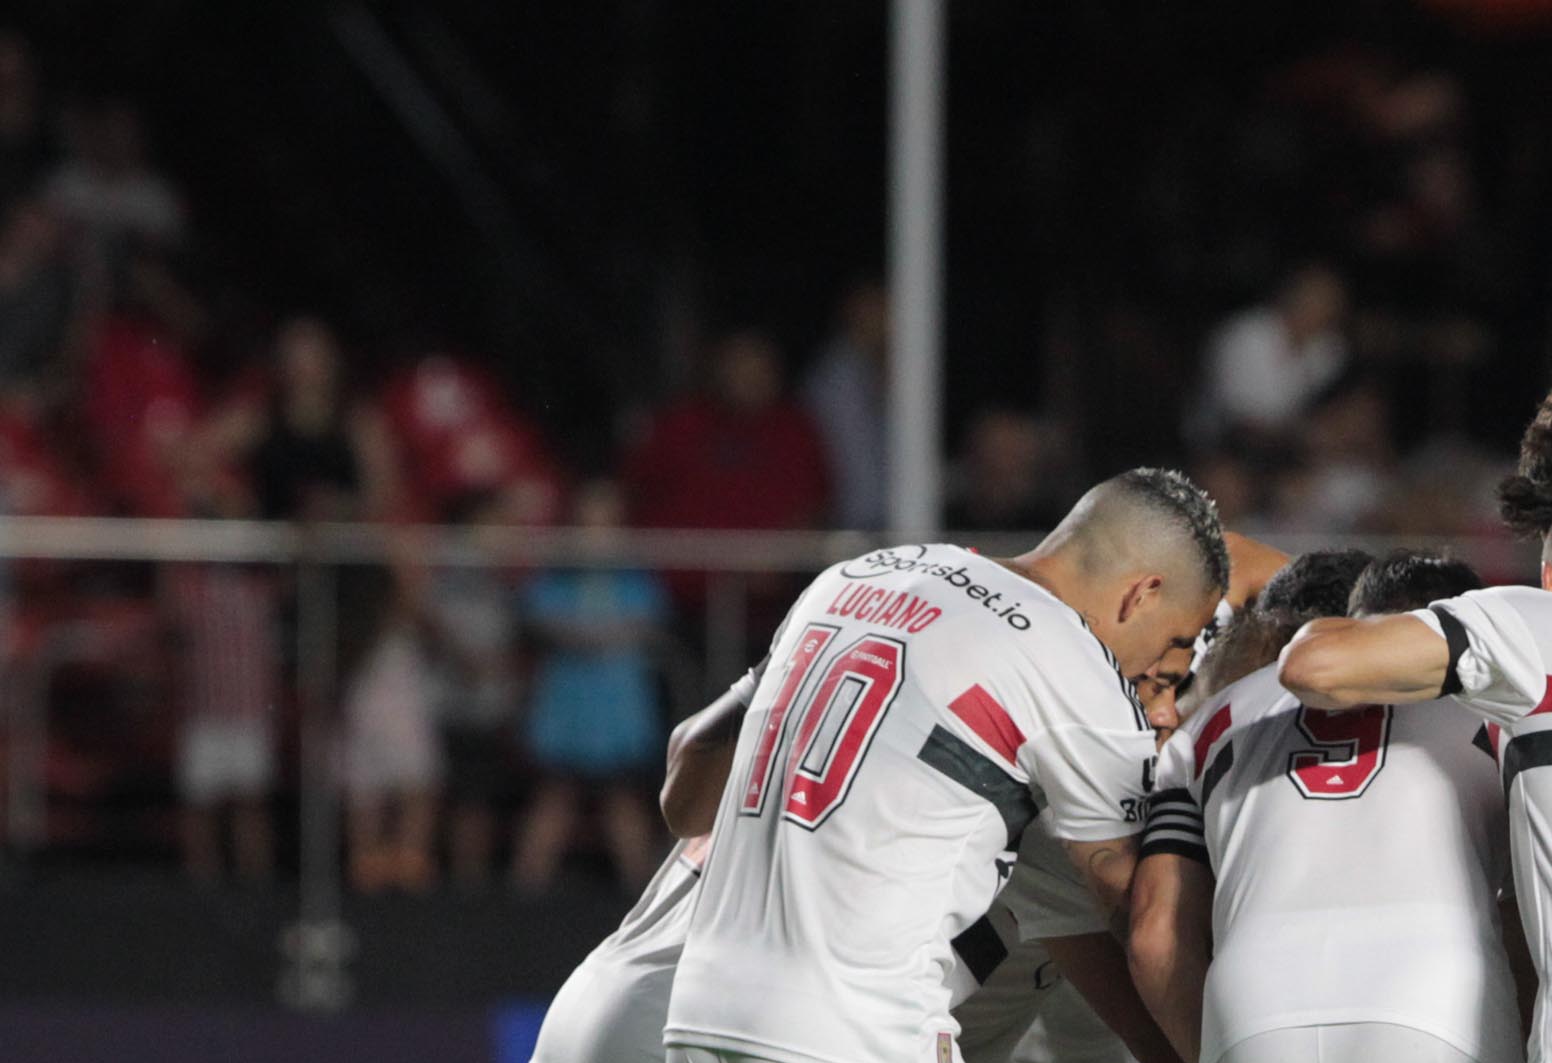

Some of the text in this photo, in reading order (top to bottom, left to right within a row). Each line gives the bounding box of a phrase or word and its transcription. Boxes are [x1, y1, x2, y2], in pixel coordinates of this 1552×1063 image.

[826, 582, 943, 635] LUCIANO
[738, 622, 907, 832] 10
[1287, 703, 1394, 800] 9
